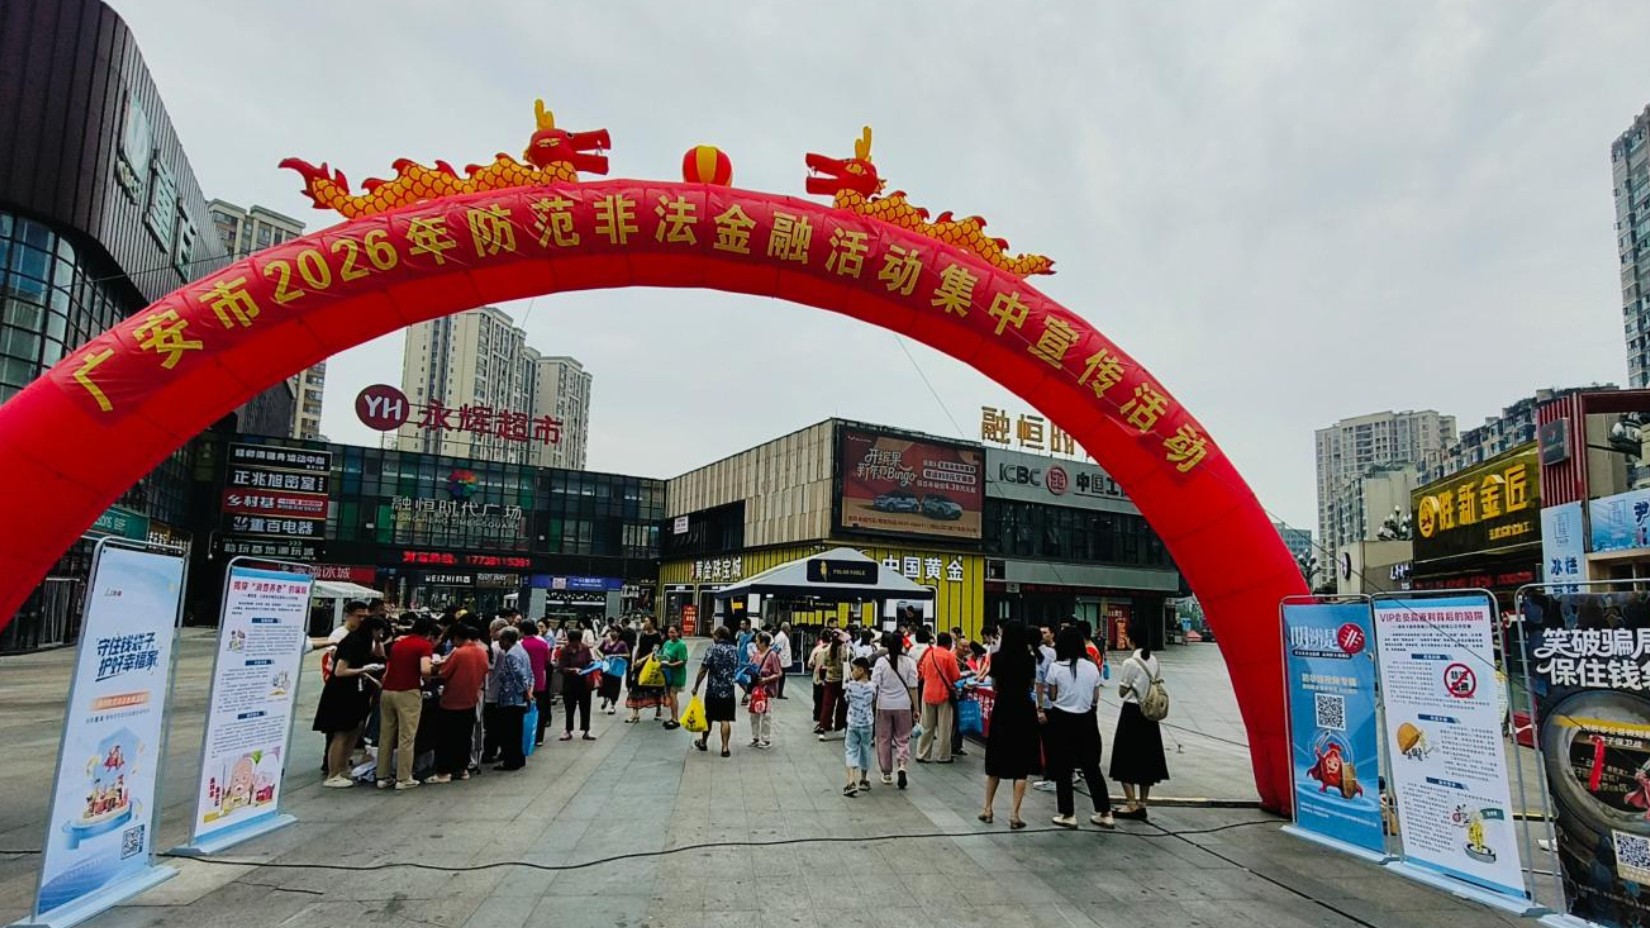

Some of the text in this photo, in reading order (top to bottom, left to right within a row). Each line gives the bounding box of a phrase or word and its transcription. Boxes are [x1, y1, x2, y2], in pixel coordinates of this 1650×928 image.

[72, 194, 1208, 475] 广安市2026年防范非法金融活动集中宣传活动
[364, 394, 403, 422] YH
[417, 399, 564, 446] 永辉超市
[981, 405, 1075, 456] 融恒时
[999, 462, 1041, 487] ICBC
[391, 495, 523, 521] 融恒时代广场
[882, 554, 964, 582] 中国黄金
[1589, 735, 1644, 749] 子保卫战
